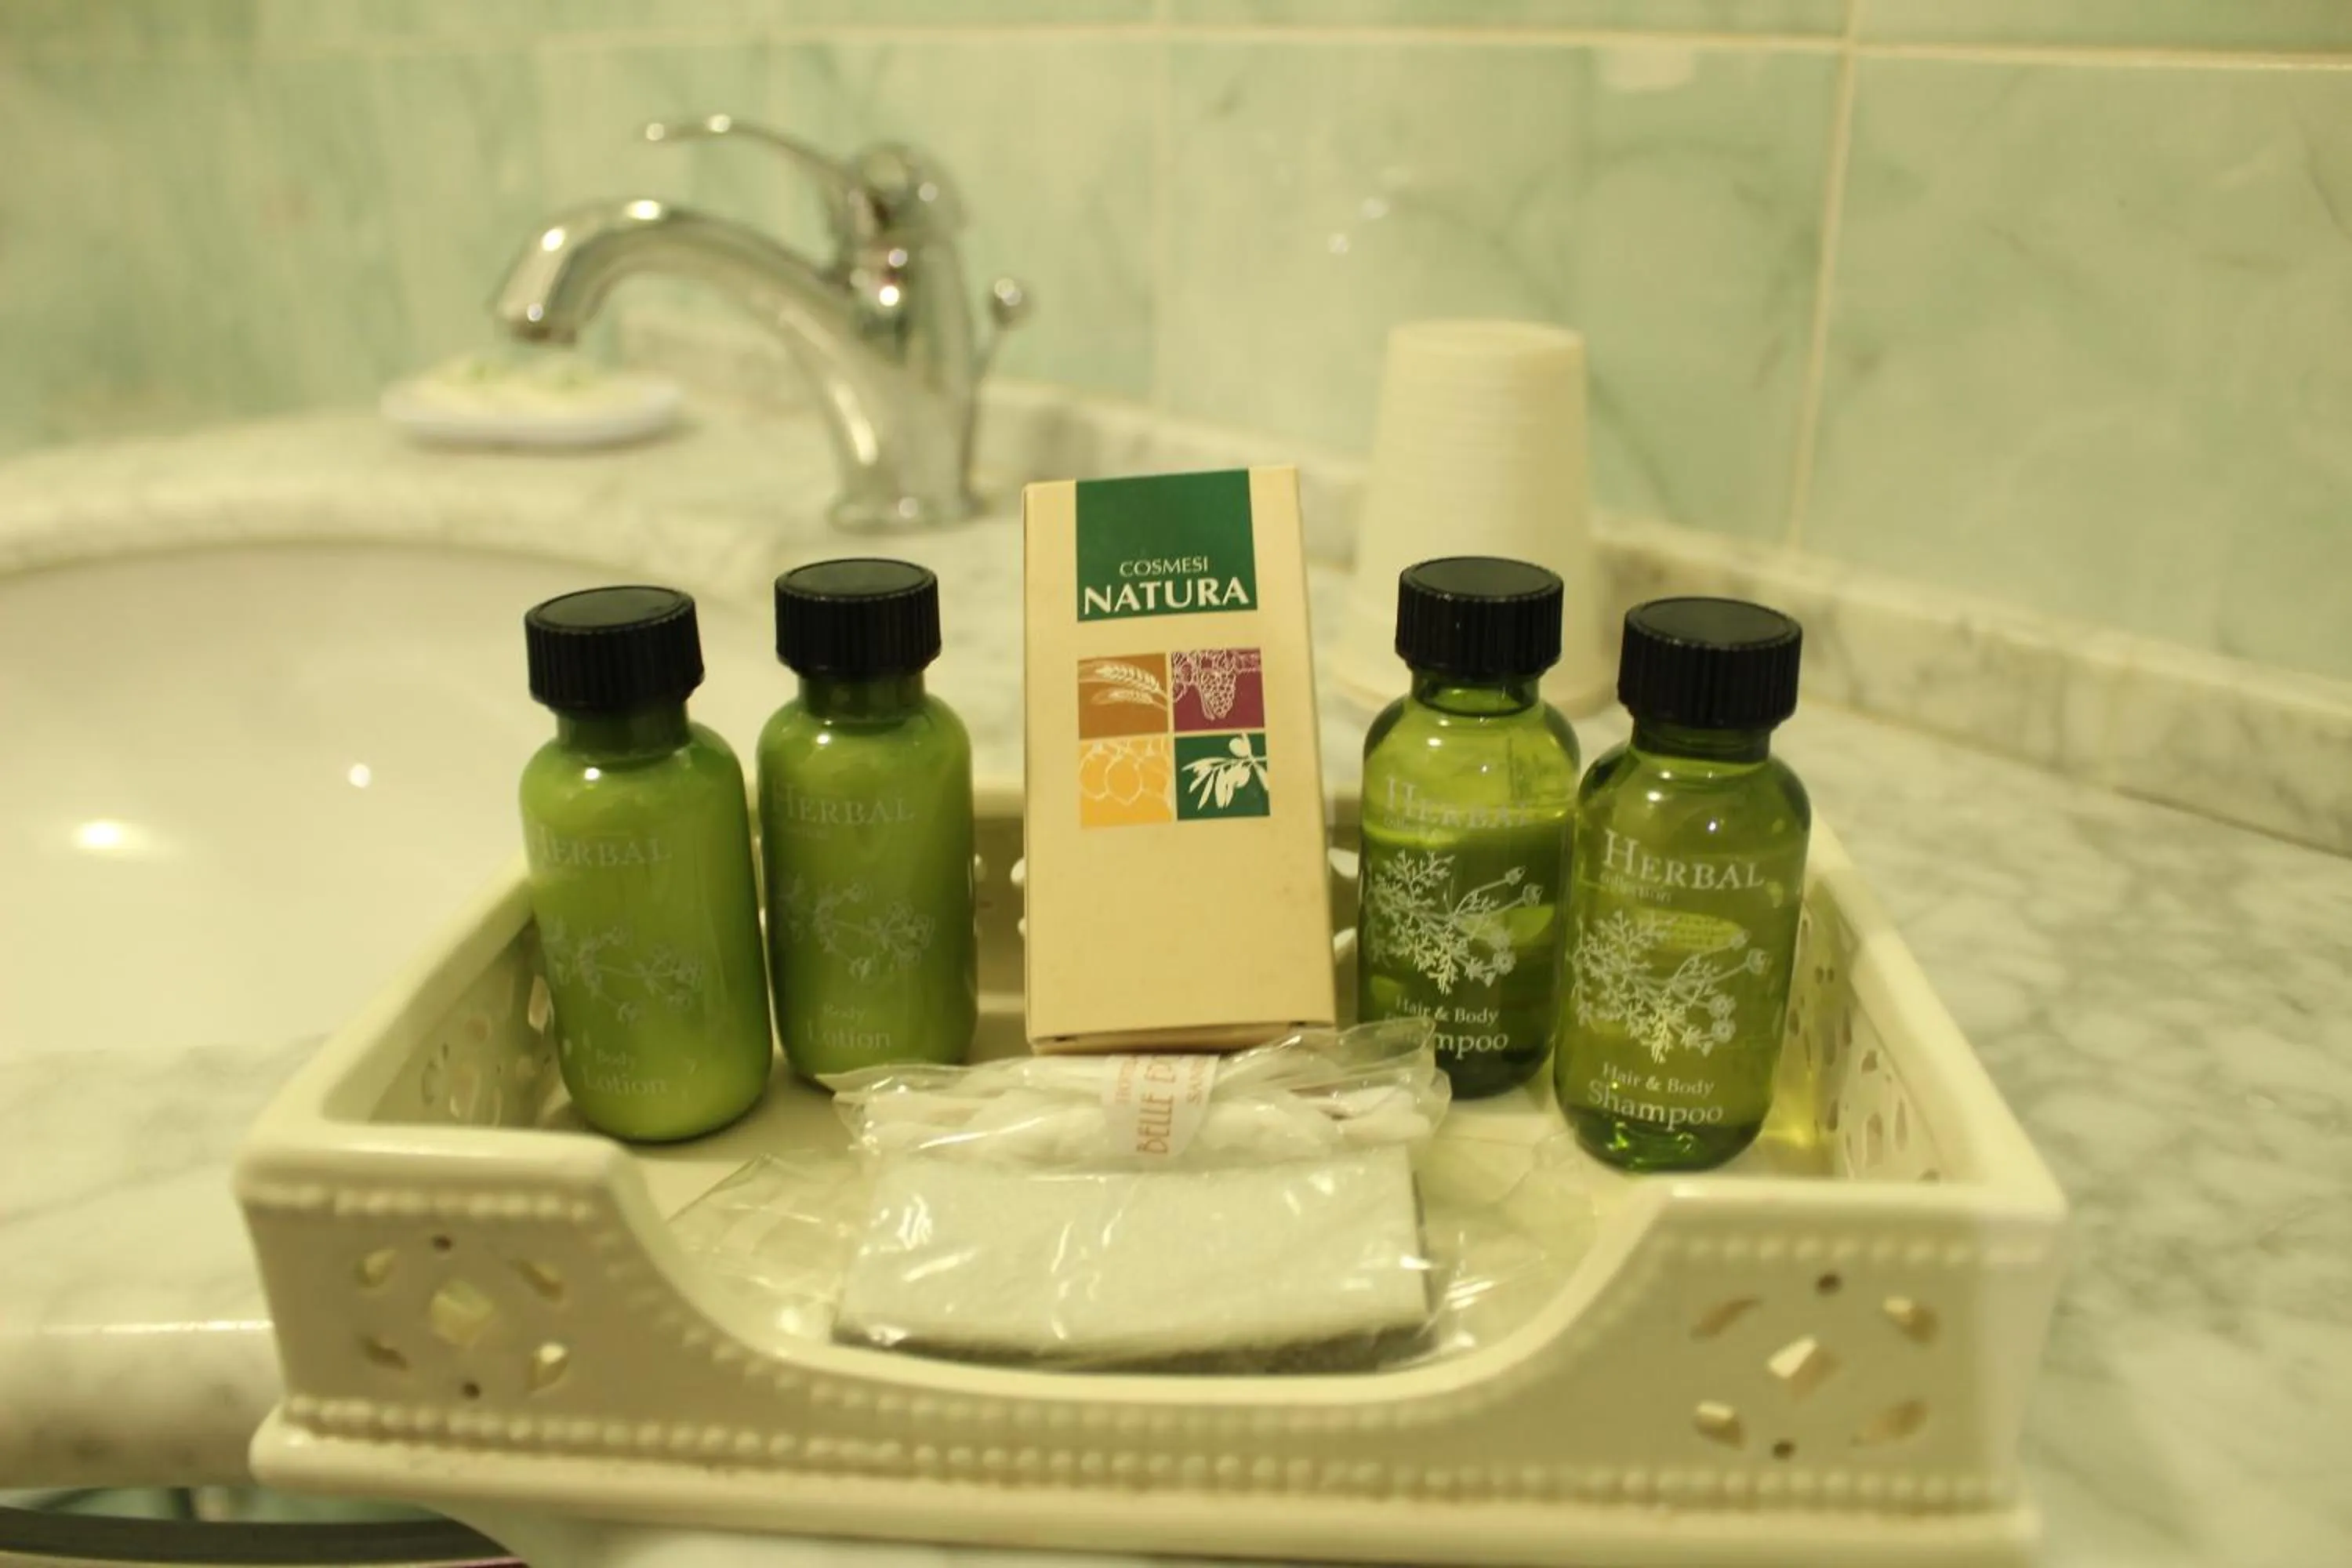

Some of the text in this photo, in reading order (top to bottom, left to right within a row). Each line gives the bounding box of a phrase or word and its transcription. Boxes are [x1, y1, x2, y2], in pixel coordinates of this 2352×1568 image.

[1120, 556, 1209, 577] COSMESI
[1083, 576, 1250, 615] NATURA
[1602, 827, 1766, 891] HERBAL
[1434, 1005, 1450, 1023] &
[1454, 1005, 1501, 1028] Body
[1433, 1033, 1510, 1061] mpoo
[581, 1064, 669, 1096] Lotion
[1602, 1060, 1716, 1100] Hair & Body
[1136, 1092, 1174, 1155] BELLE
[1587, 1077, 1725, 1133] Shampoo
